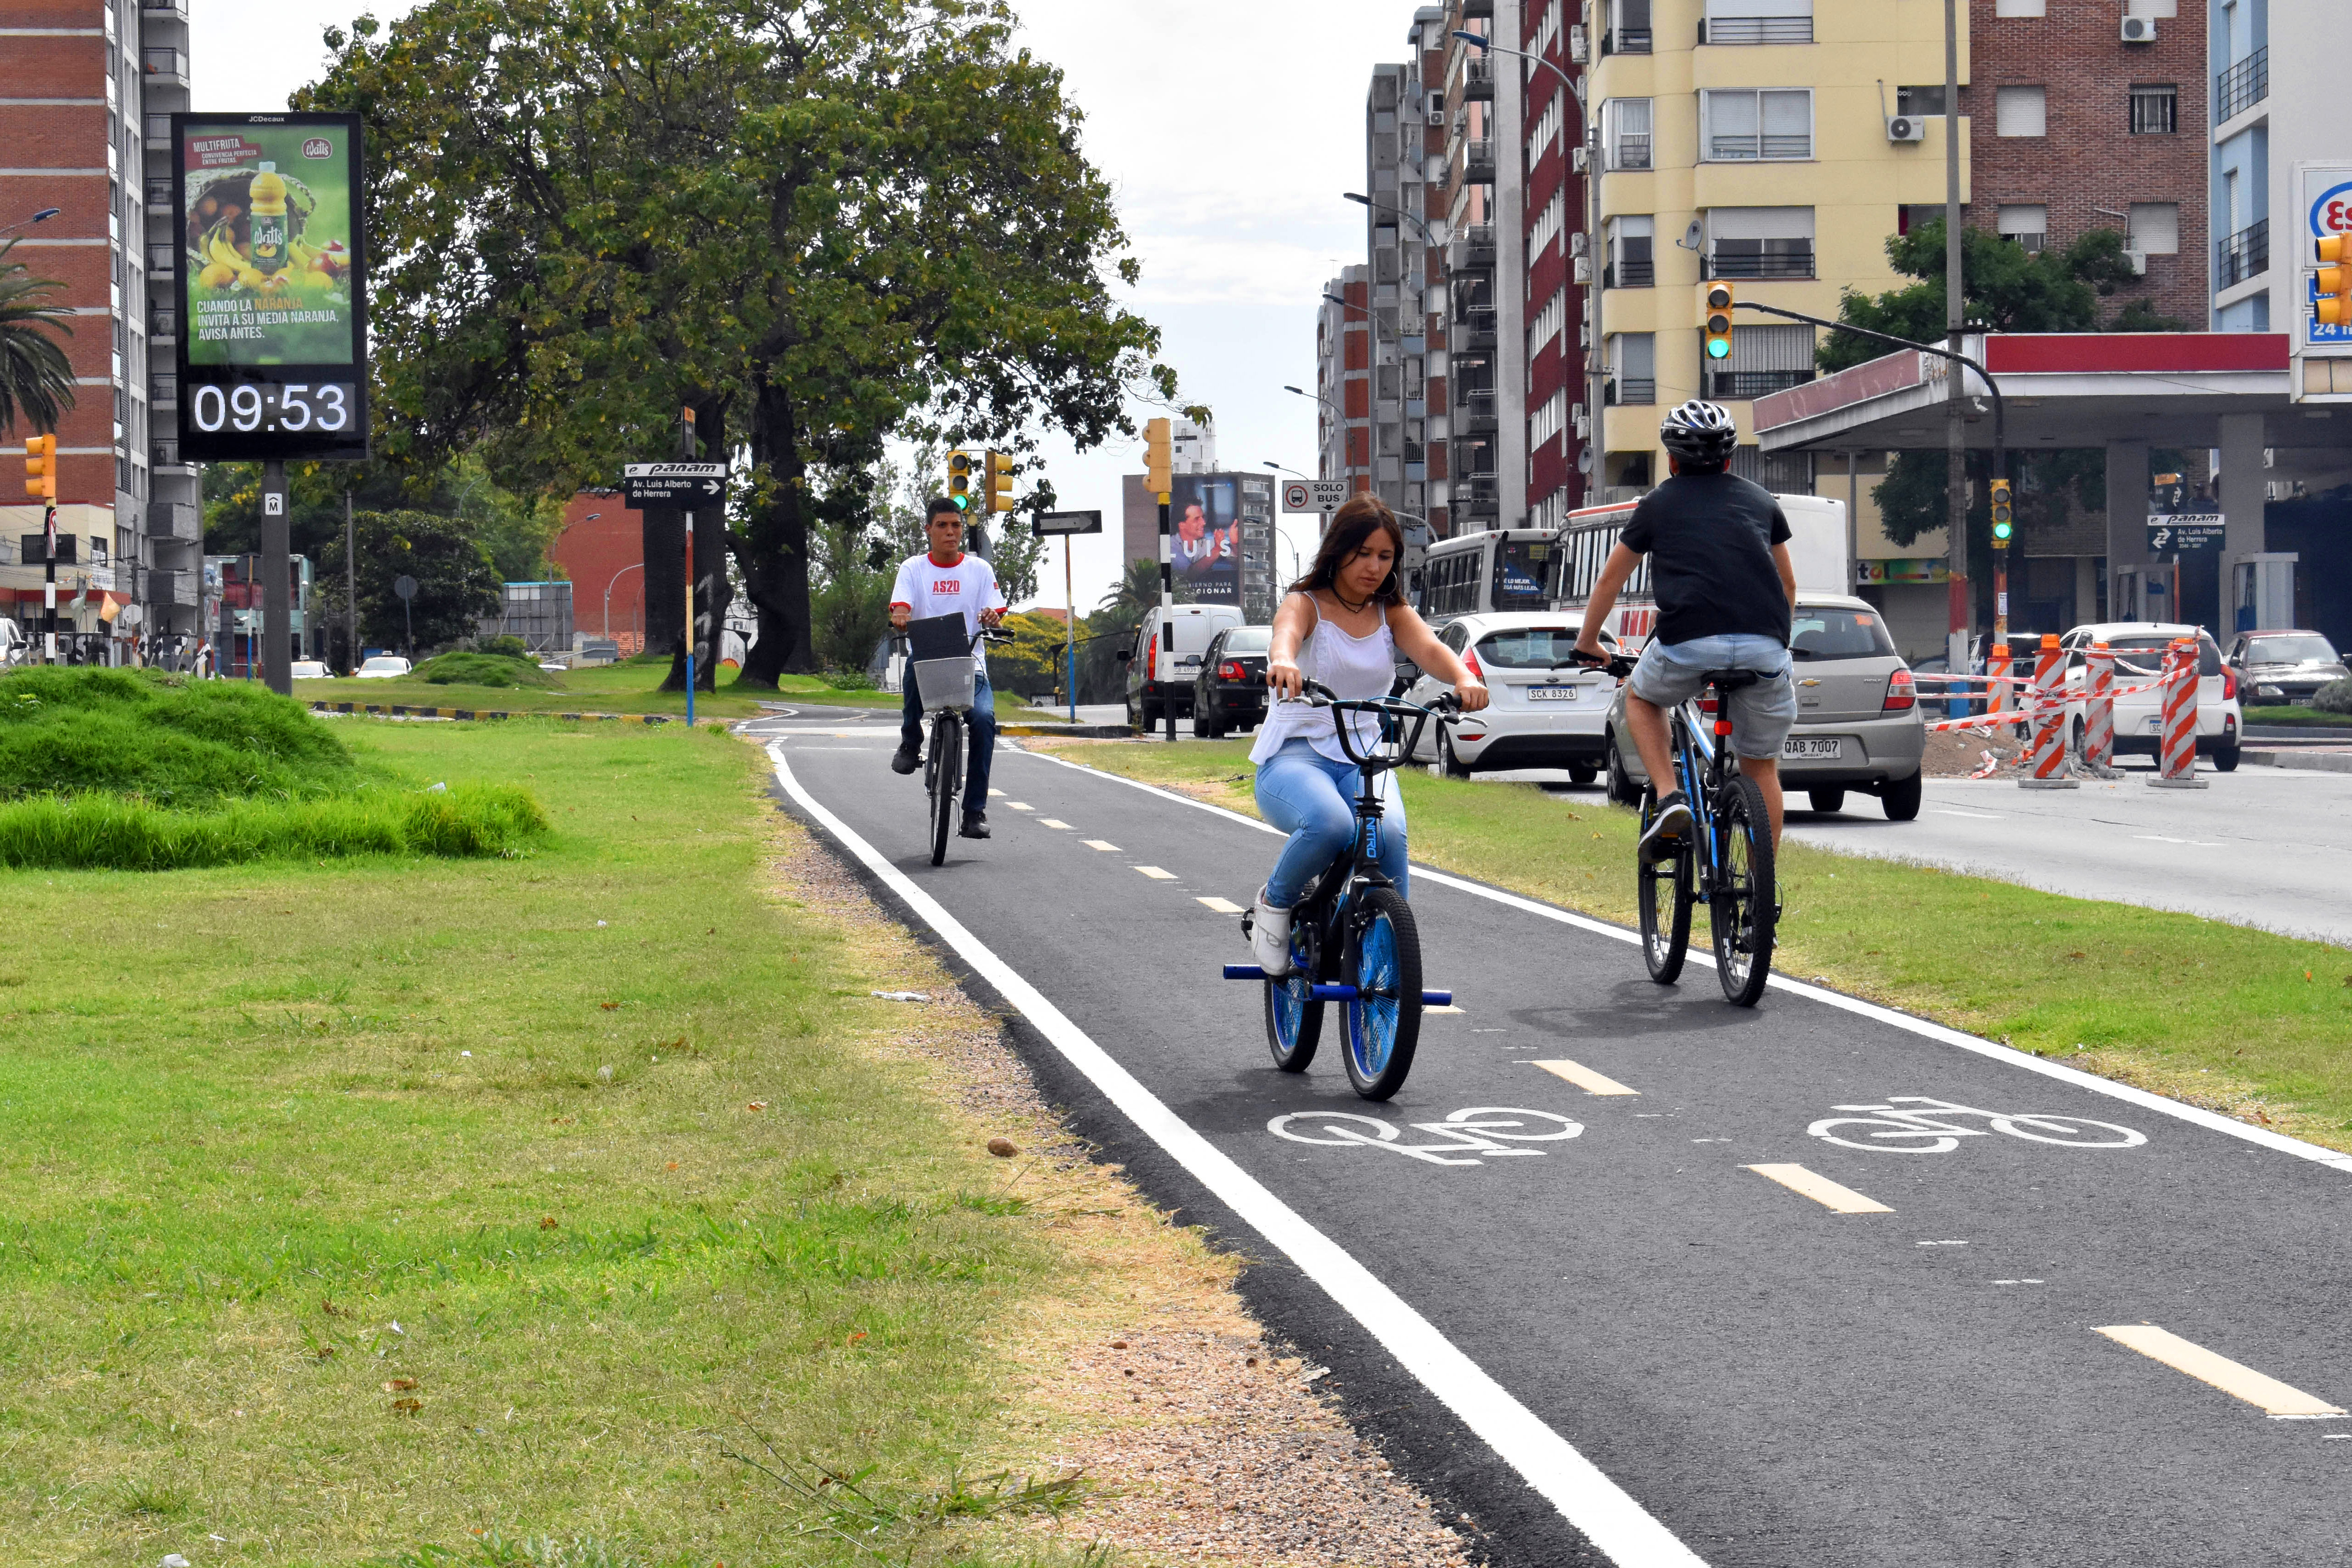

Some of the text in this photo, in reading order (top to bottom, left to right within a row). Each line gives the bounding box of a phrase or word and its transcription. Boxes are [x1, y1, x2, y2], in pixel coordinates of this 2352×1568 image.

[193, 138, 240, 153] MULTIFRUTA
[197, 297, 303, 313] CUANDO LA NARANJA
[198, 310, 338, 326] INVITA A SU MEDIA NARANJA,
[199, 326, 265, 340] AVISA ANTES.
[2314, 324, 2336, 335] 24
[195, 385, 347, 431] 09:53
[649, 465, 717, 475] panam
[2167, 515, 2219, 524] panam
[1170, 539, 1231, 557] UIS
[1552, 689, 1574, 698] 8326
[1784, 740, 1838, 753] QAB 7007
[1366, 817, 1377, 858] NITRO
